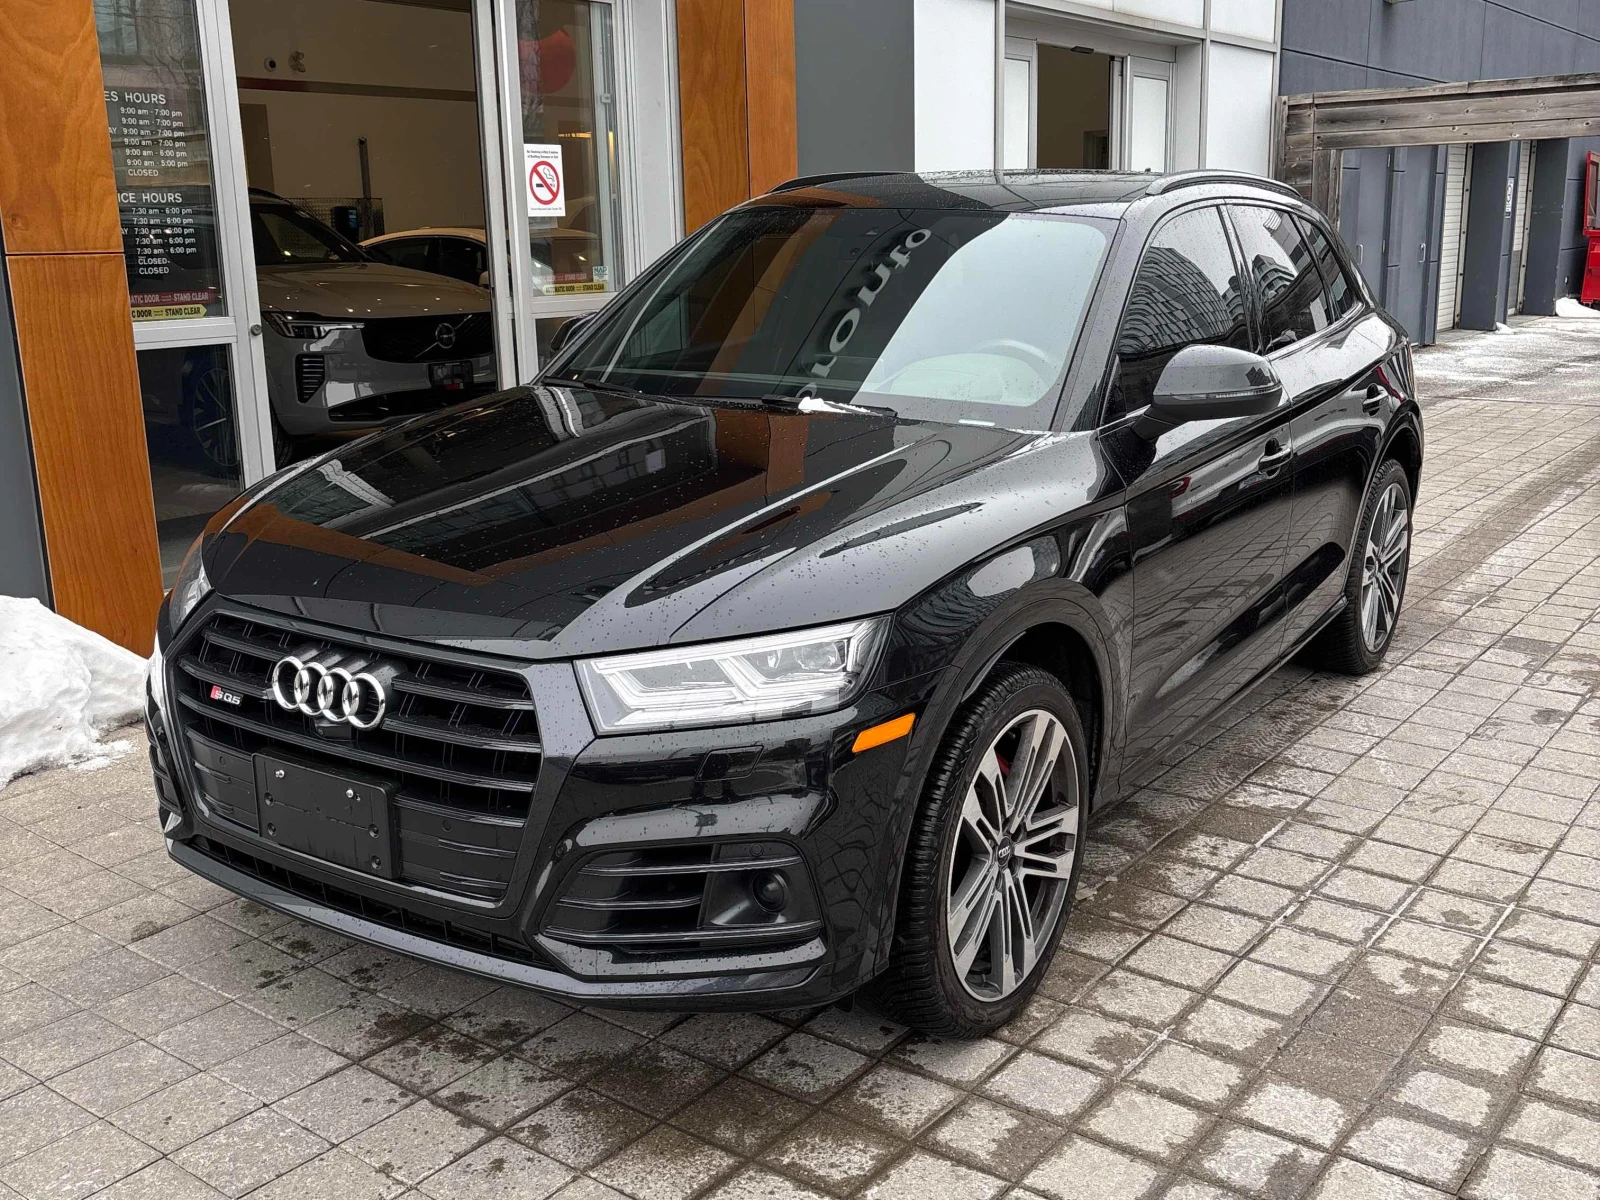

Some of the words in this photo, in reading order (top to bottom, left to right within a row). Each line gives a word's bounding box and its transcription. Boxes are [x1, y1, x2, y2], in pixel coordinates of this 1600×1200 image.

[124, 92, 166, 104] HOURS
[118, 193, 136, 203] ICE
[142, 192, 182, 203] HOURS
[144, 294, 160, 303] DOOR
[174, 293, 191, 302] STAND
[192, 292, 208, 300] CLEAR
[165, 308, 183, 316] STAND
[184, 307, 201, 315] CLEAR
[214, 690, 240, 705] SQ5
